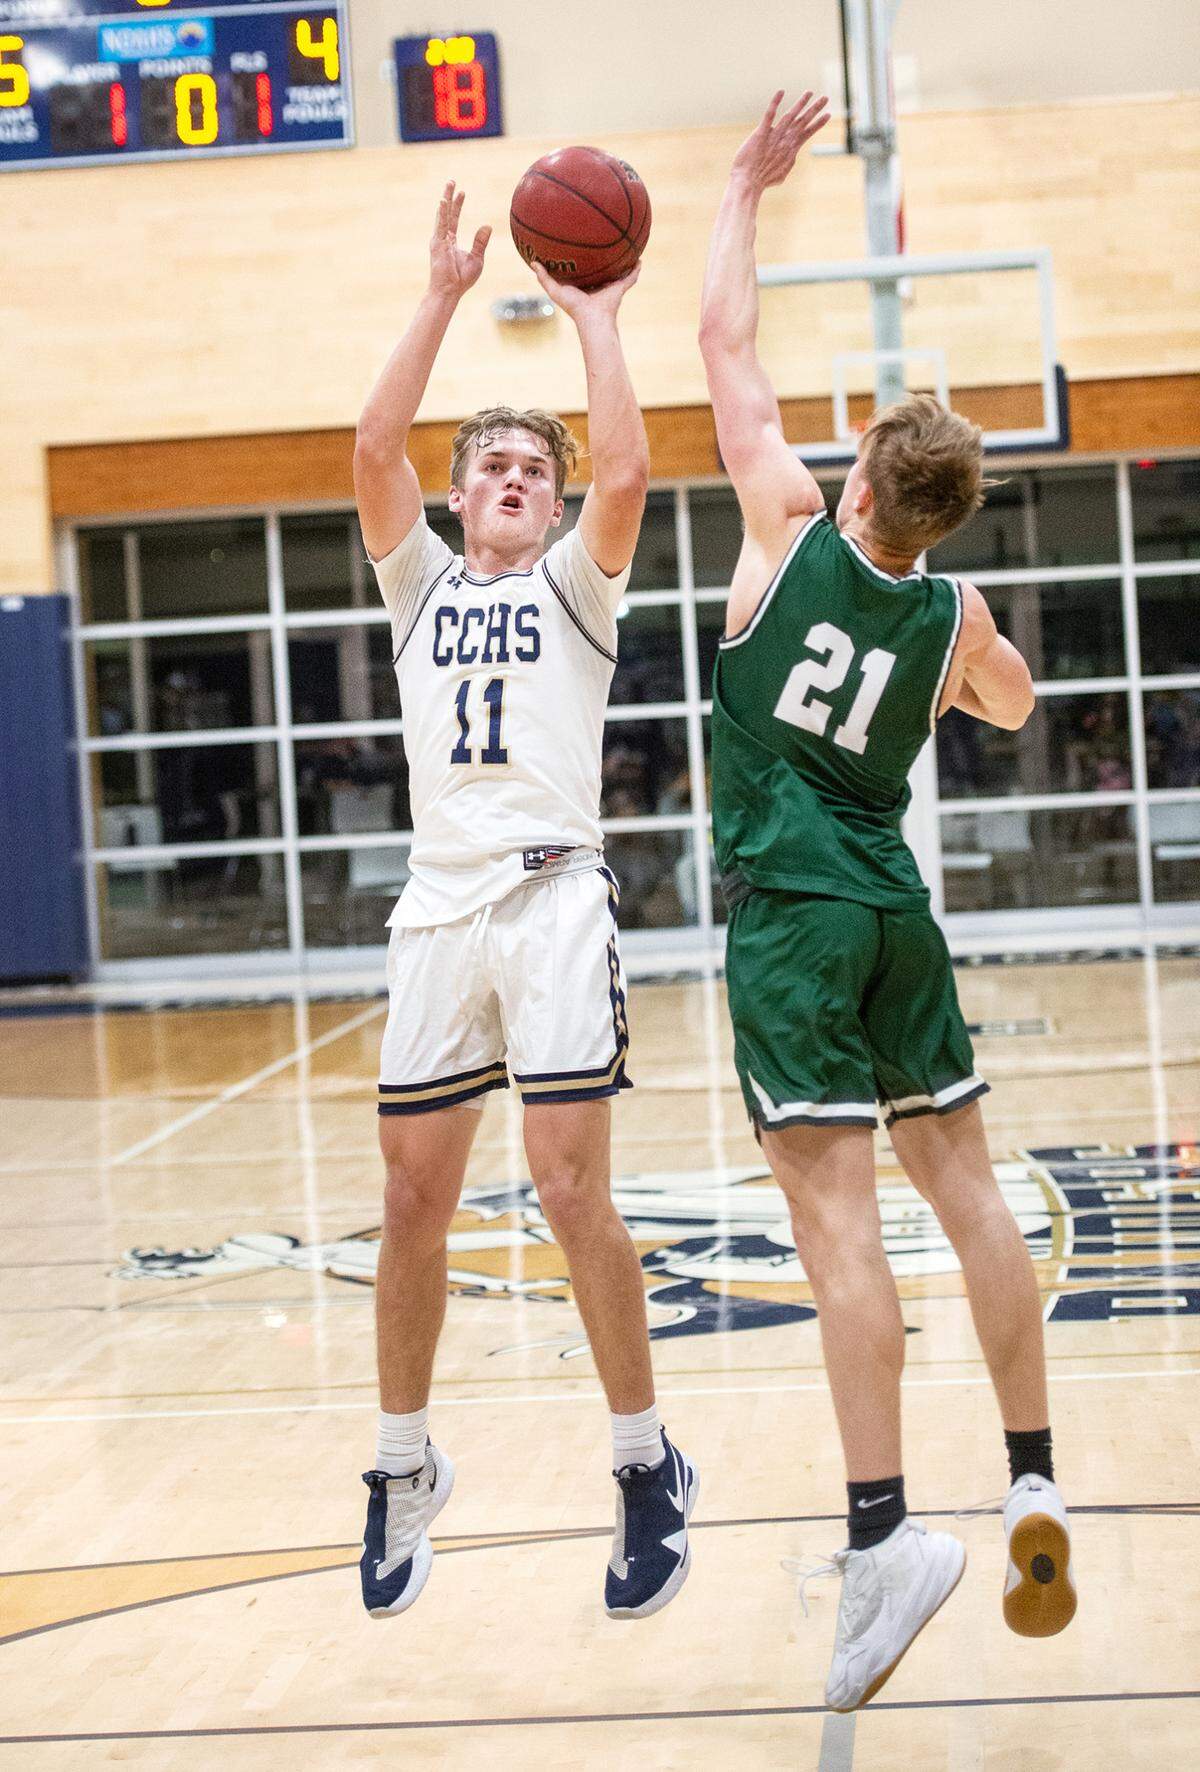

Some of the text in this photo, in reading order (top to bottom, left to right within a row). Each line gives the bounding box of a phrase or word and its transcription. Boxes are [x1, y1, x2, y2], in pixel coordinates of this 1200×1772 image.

[295, 18, 339, 81] 4
[109, 82, 127, 147] 1
[175, 73, 218, 145] 0
[256, 72, 272, 136] 1
[432, 603, 541, 667] CCHS
[772, 621, 897, 755] 21
[450, 678, 509, 765] 11
